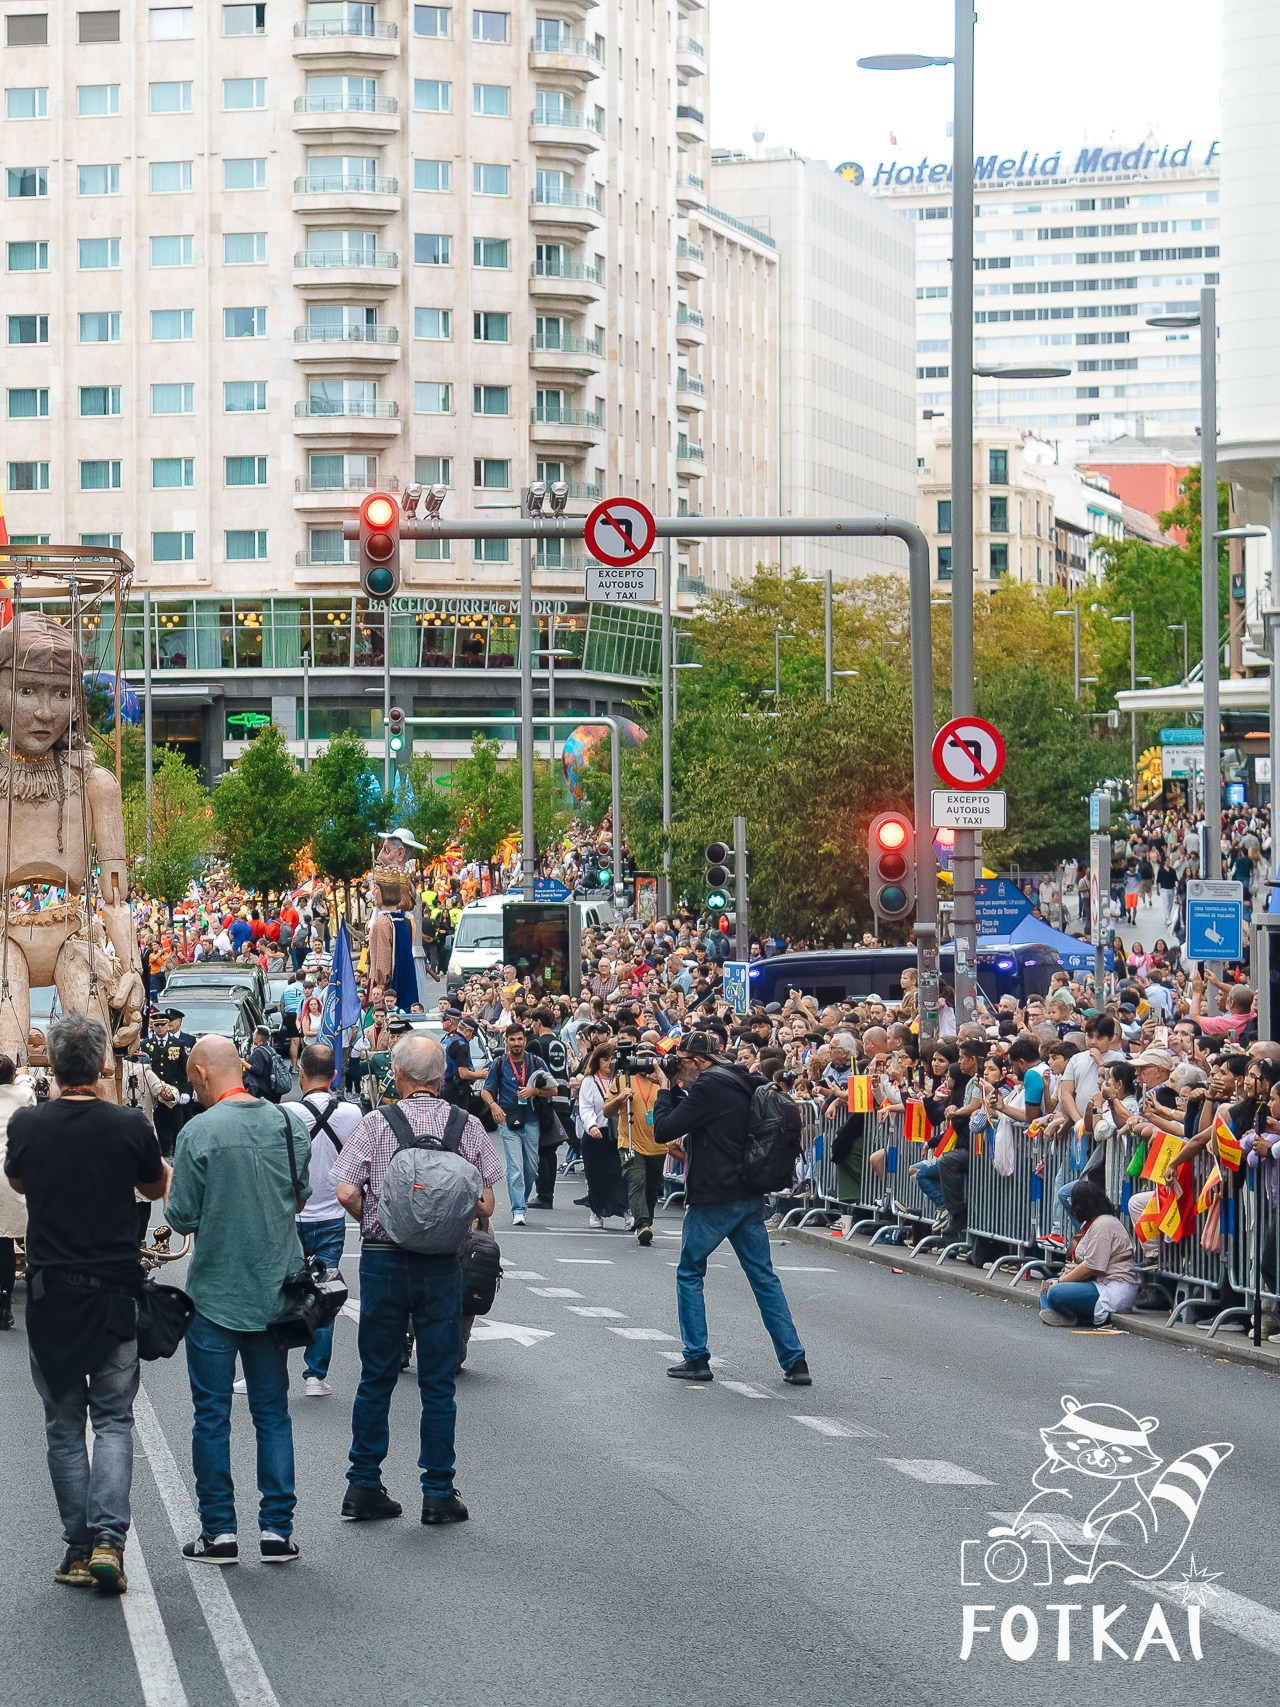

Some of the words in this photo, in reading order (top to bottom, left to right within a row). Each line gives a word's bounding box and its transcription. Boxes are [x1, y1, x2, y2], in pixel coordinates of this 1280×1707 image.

[973, 150, 1061, 180] Meliá
[1074, 140, 1192, 174] Madrid
[598, 570, 644, 578] EXCEPTO
[440, 599, 489, 613] TORRE
[491, 600, 505, 613] de
[509, 600, 568, 614] MDRID
[946, 806, 990, 814] AUTOBUS
